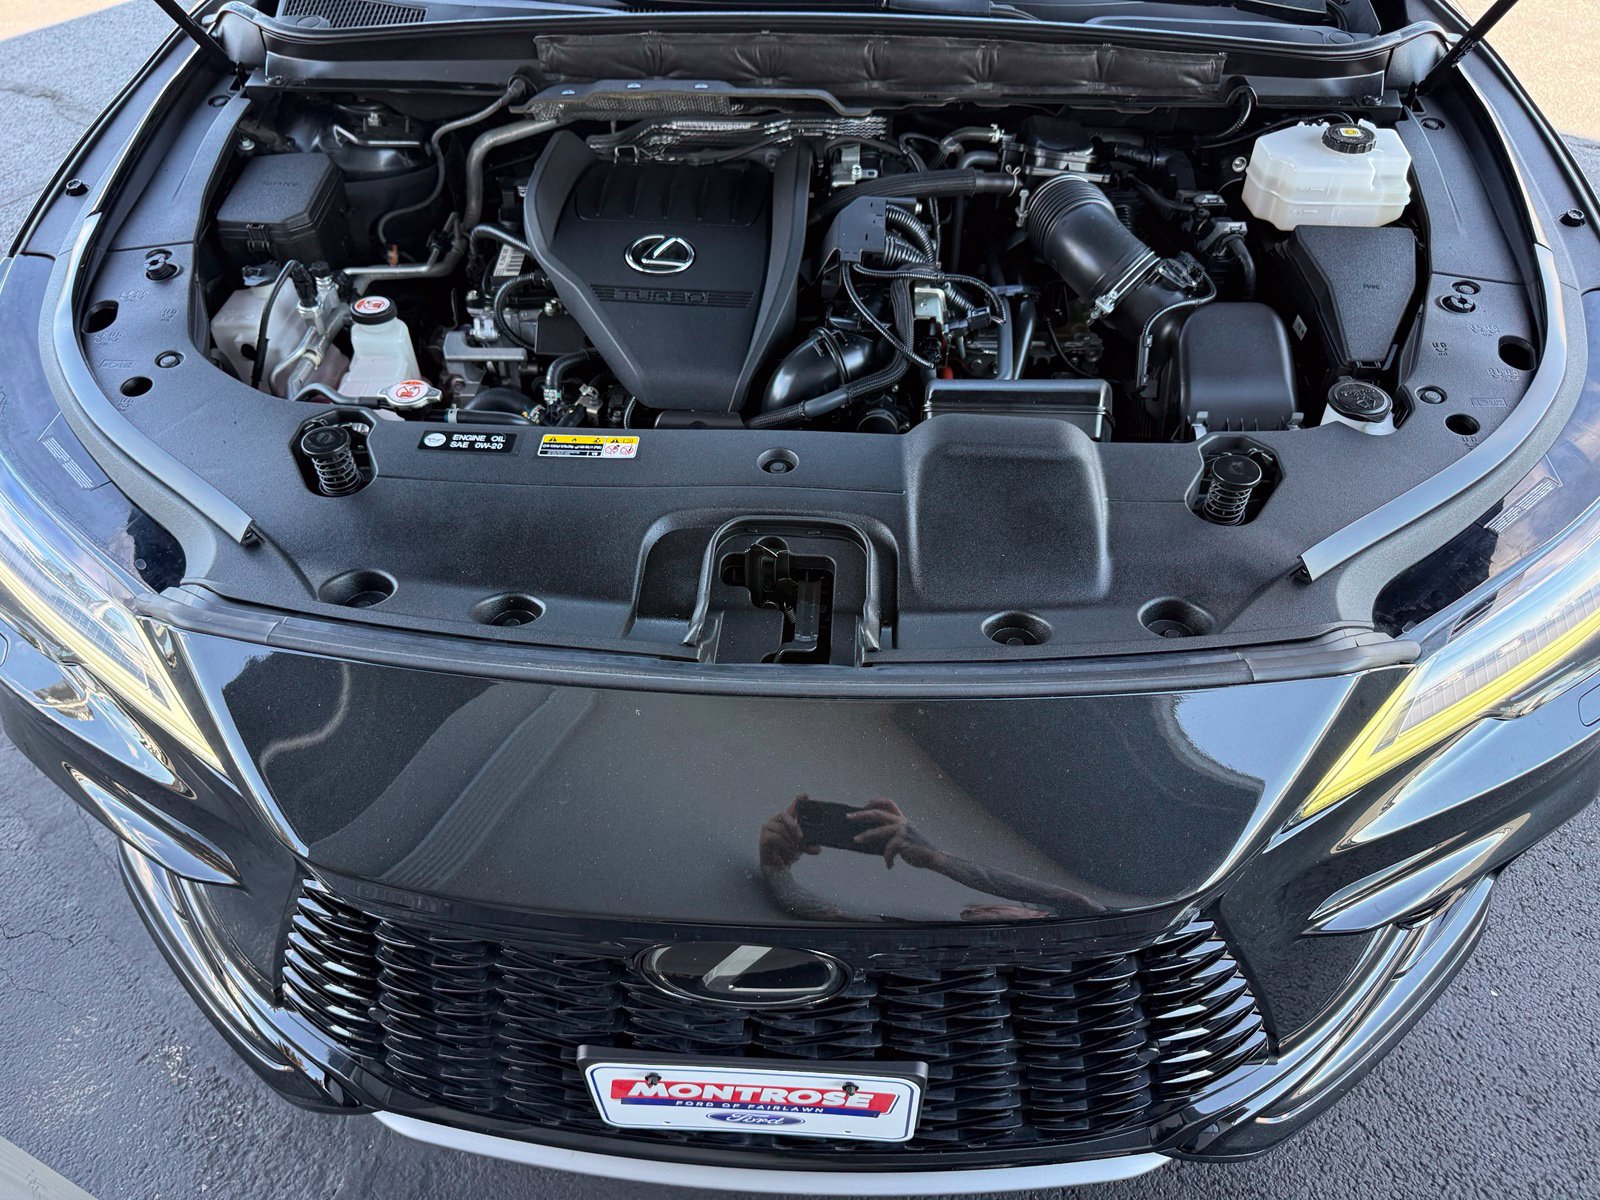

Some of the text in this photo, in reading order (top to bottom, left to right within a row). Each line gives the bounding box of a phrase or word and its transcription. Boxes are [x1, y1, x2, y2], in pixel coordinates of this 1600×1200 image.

[616, 288, 707, 304] TURBO
[452, 433, 506, 443] ENGINE OIL
[449, 441, 504, 450] SAE 0W-20
[628, 1080, 875, 1109] MONTROSE
[675, 1100, 824, 1114] FORD OF FAIRLAWN
[726, 1111, 784, 1125] Ford
